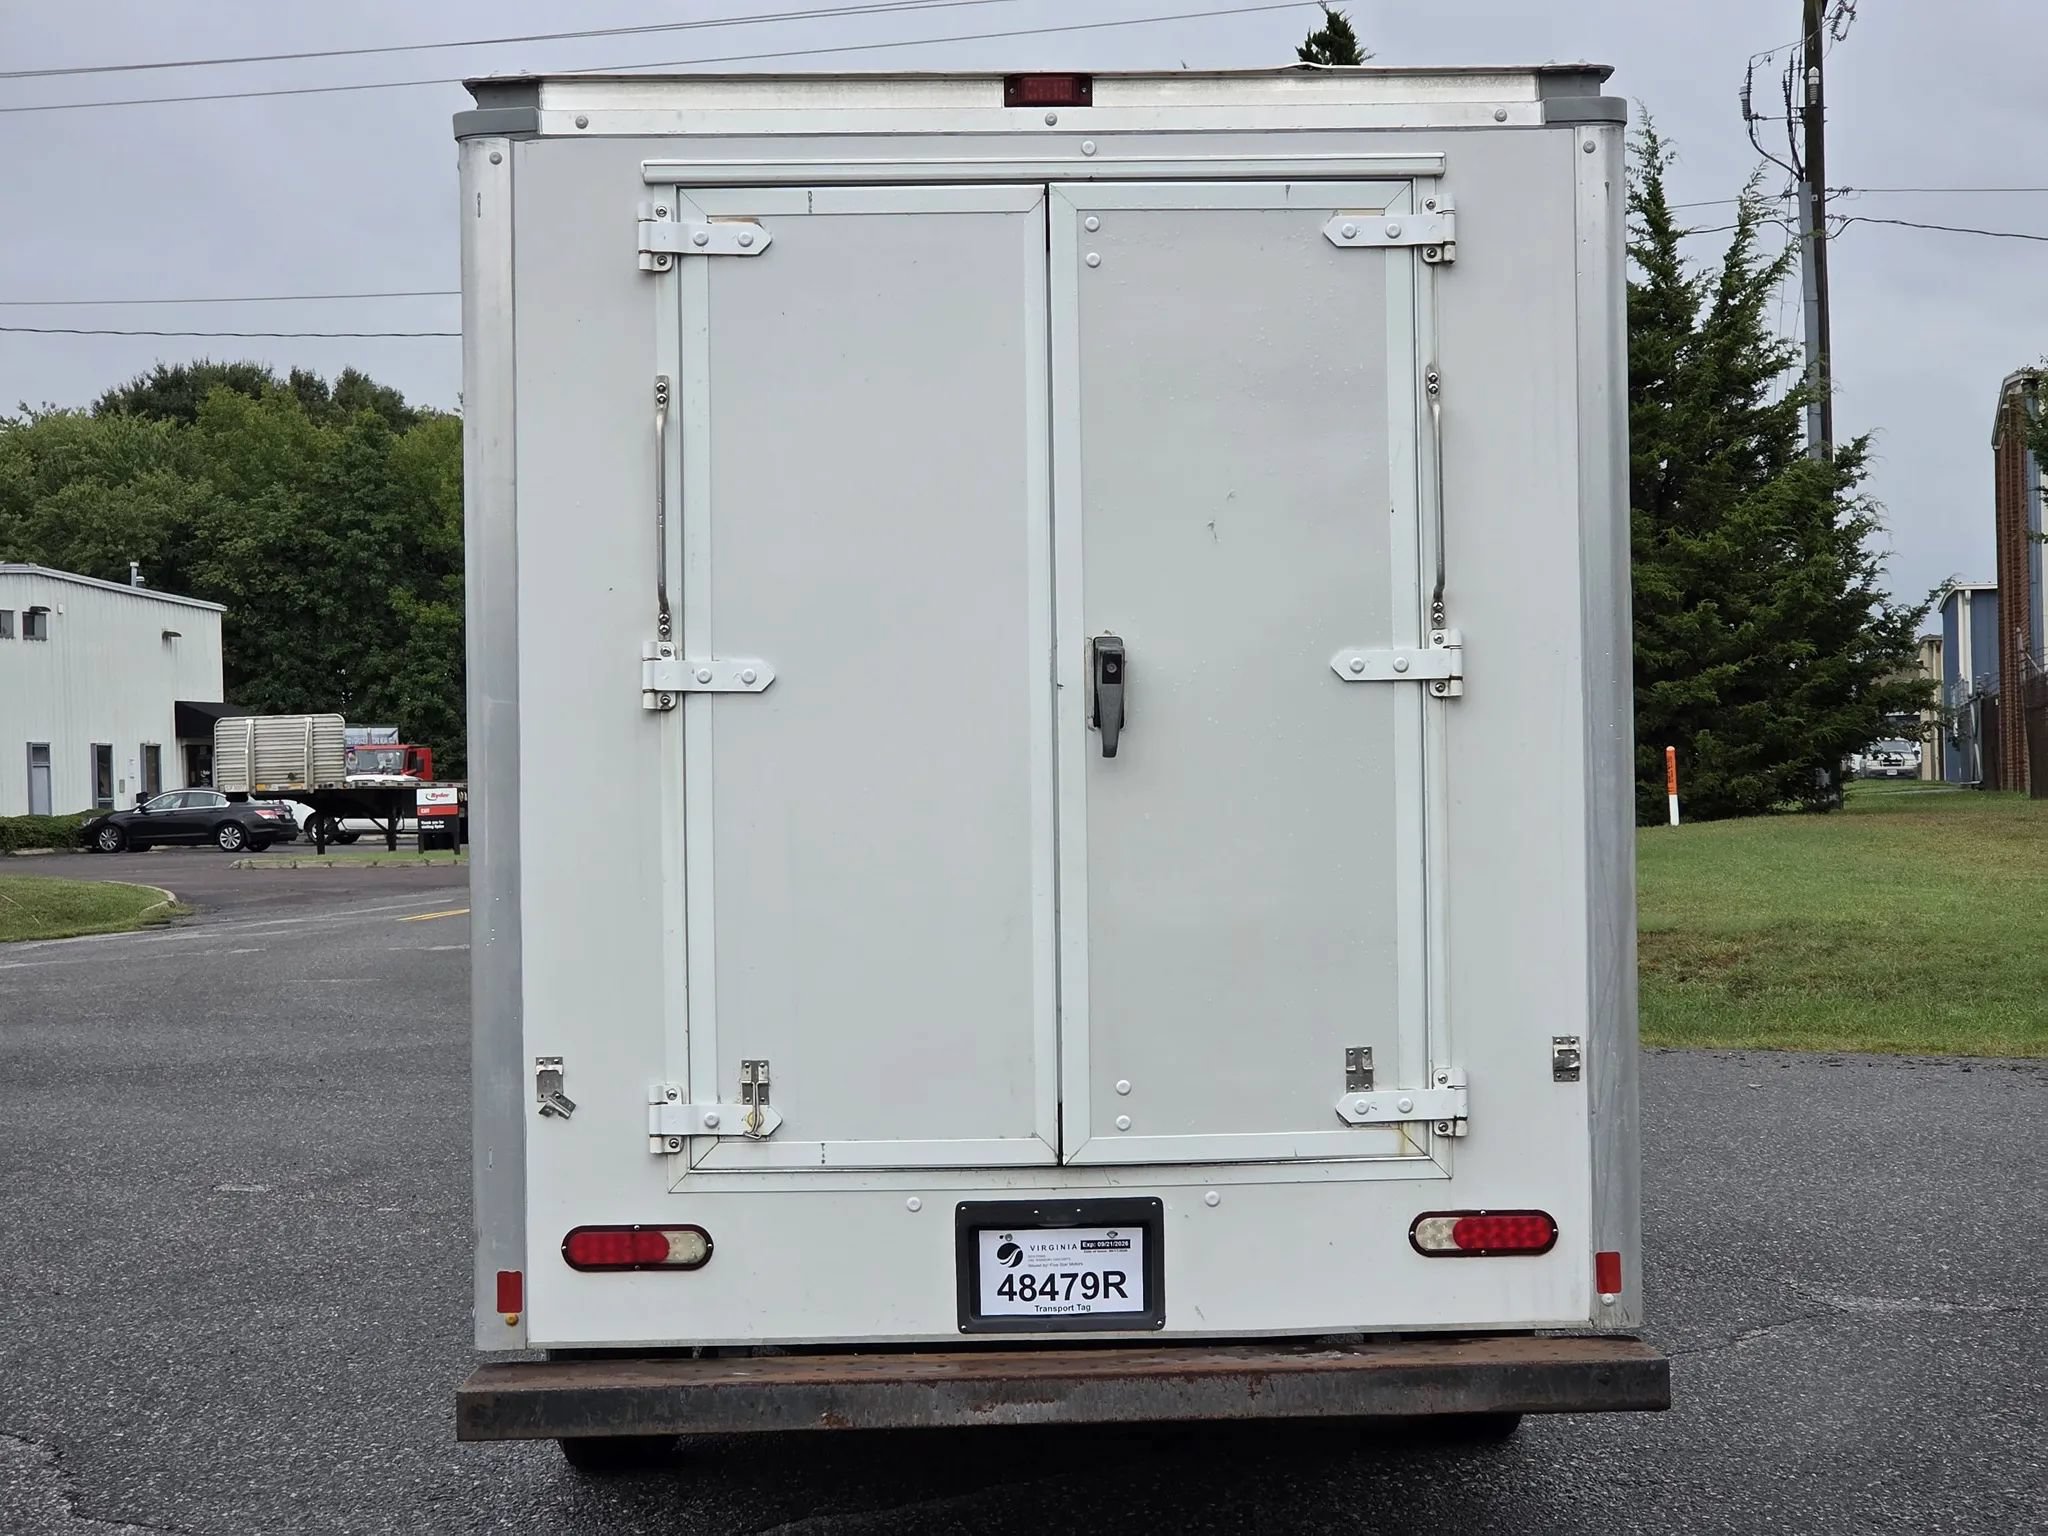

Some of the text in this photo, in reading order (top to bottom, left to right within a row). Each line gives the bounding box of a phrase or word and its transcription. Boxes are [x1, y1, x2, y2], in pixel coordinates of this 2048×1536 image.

[1029, 1243, 1078, 1252] VIRGINIA
[997, 1270, 1128, 1302] 48479R
[1034, 1303, 1091, 1313] Transport Tag
